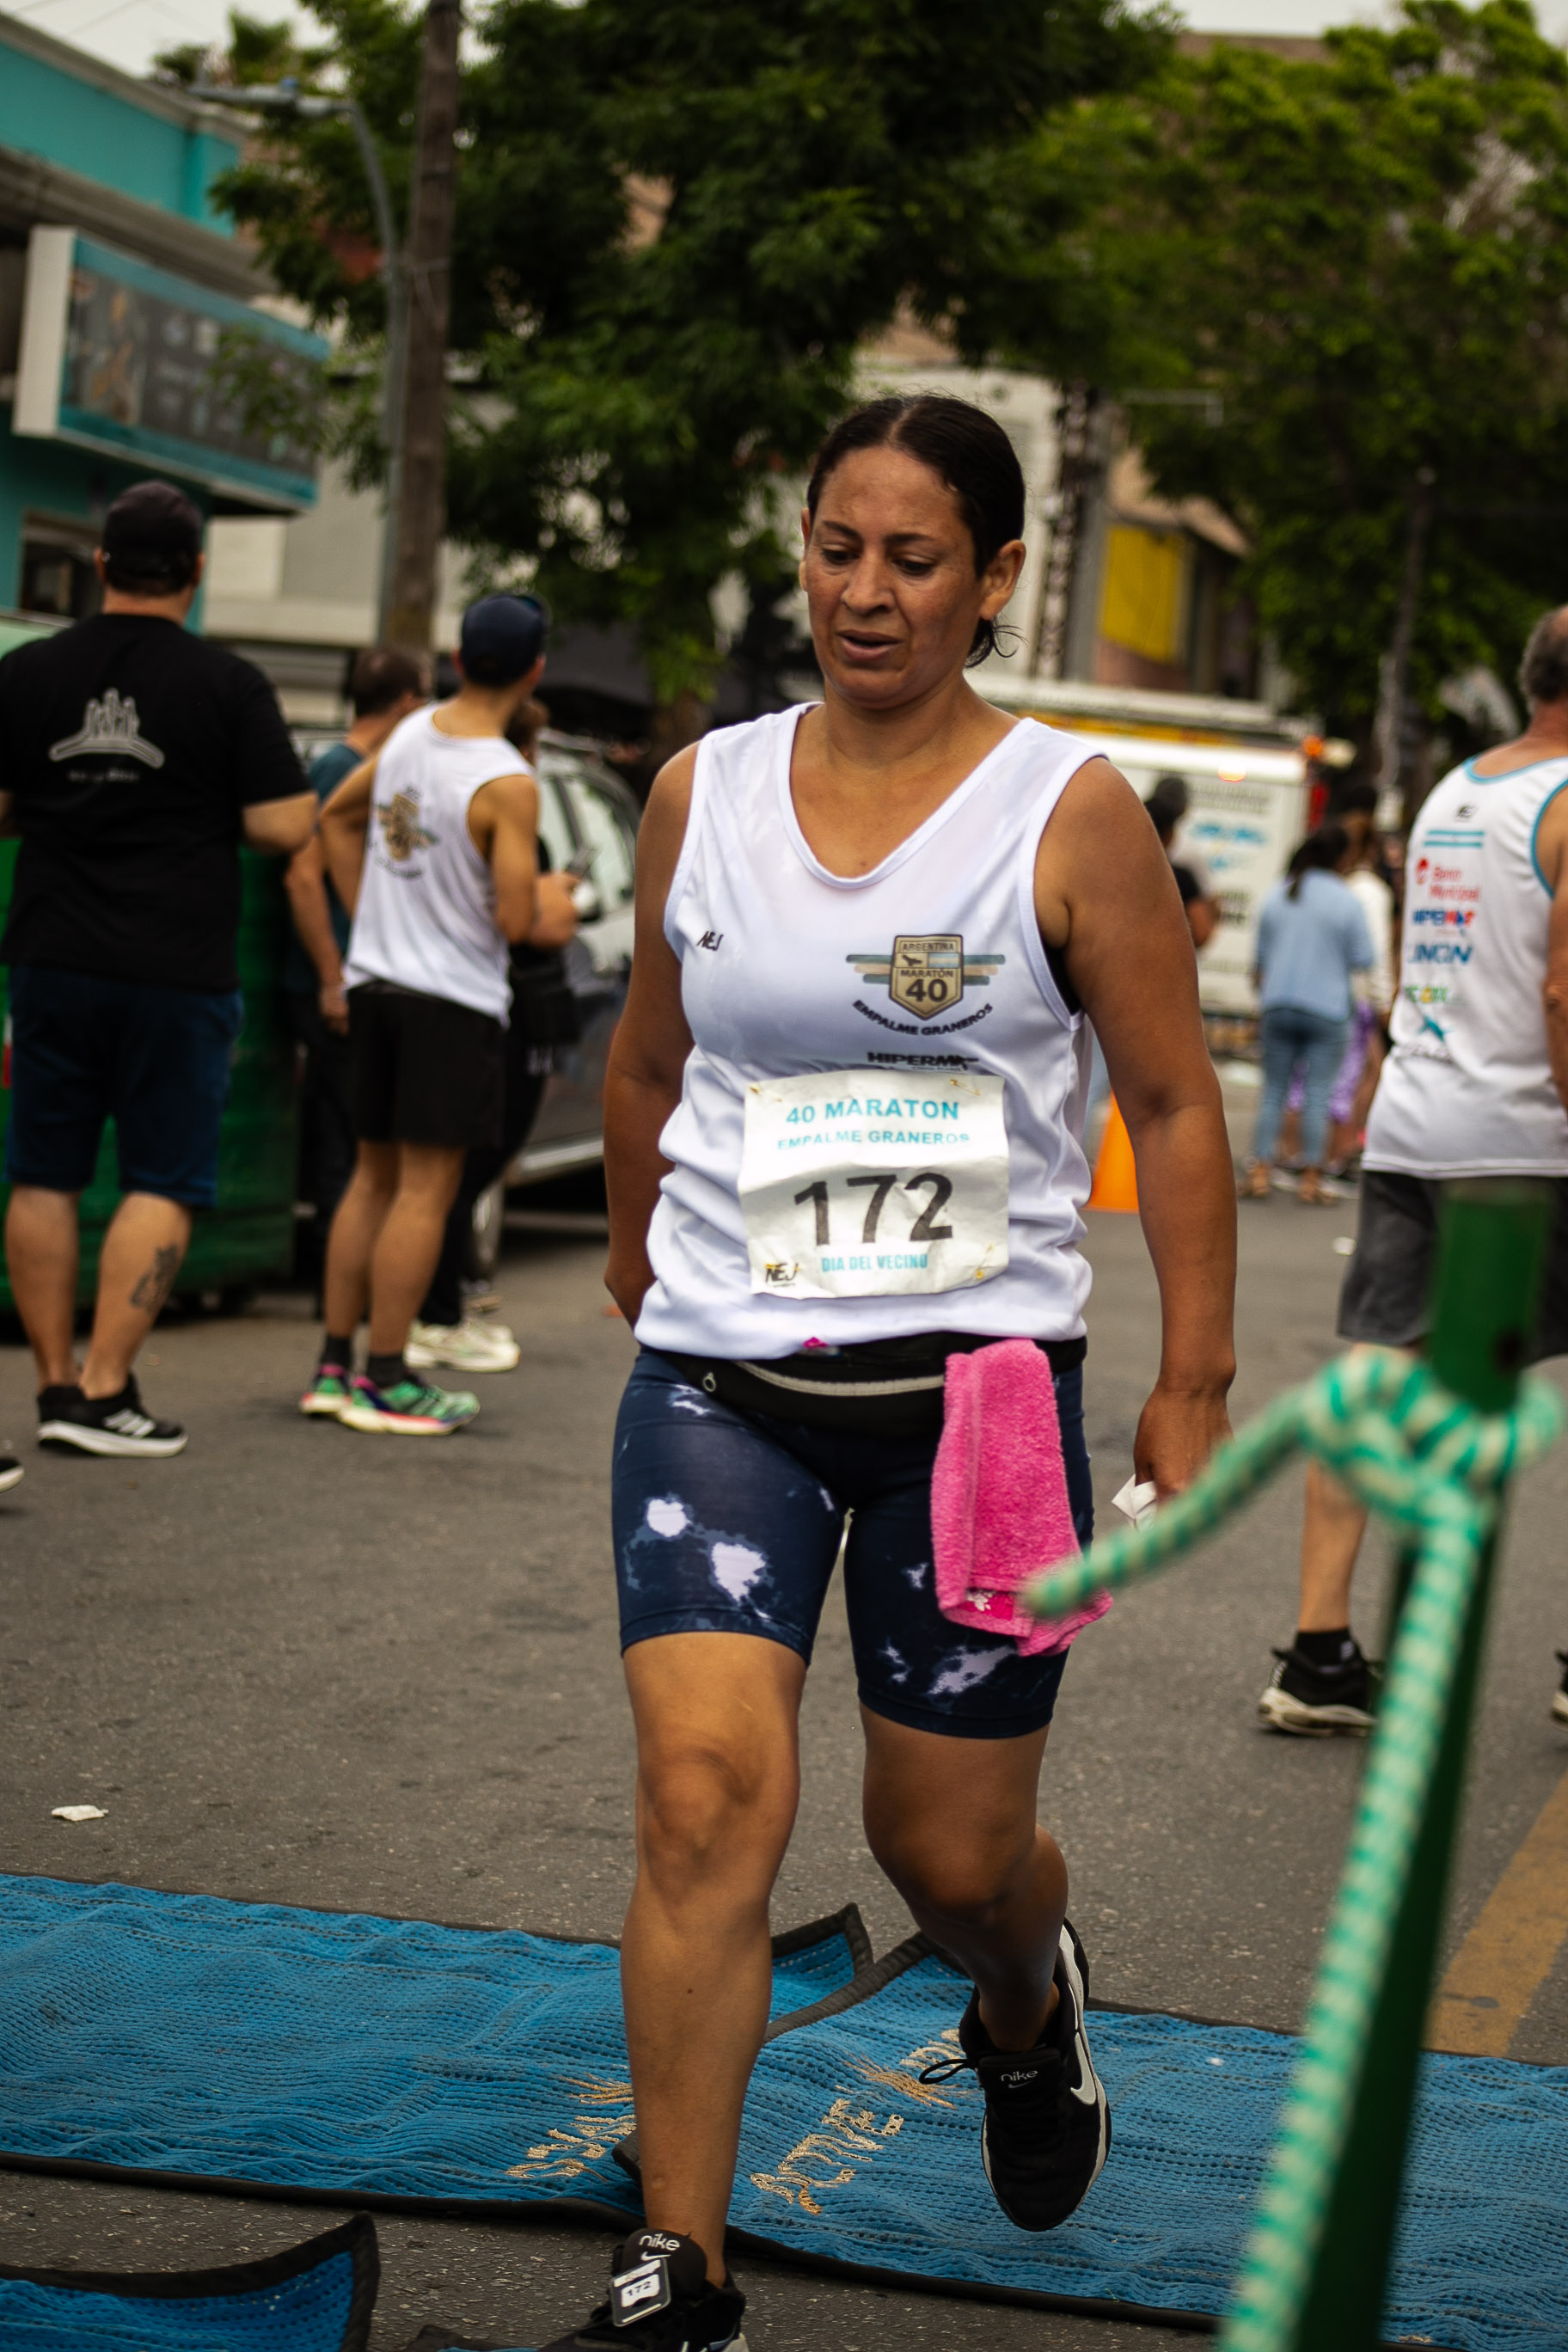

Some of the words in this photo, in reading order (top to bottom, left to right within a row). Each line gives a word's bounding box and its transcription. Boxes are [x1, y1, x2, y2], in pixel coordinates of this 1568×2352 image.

[902, 943, 955, 952] ARGENTINA
[905, 978, 949, 1002] 40
[852, 999, 919, 1035] EMPALME
[921, 1003, 994, 1036] GRANEROS
[786, 1106, 816, 1124] 40
[825, 1099, 959, 1120] MARATON
[777, 1130, 862, 1149] EMPALME
[868, 1130, 971, 1144] GRANEROS
[793, 1172, 953, 1246] 172
[821, 1257, 845, 1273] DIA
[849, 1256, 872, 1271] DEL
[877, 1253, 928, 1270] VECINO
[626, 2281, 652, 2296] 172
